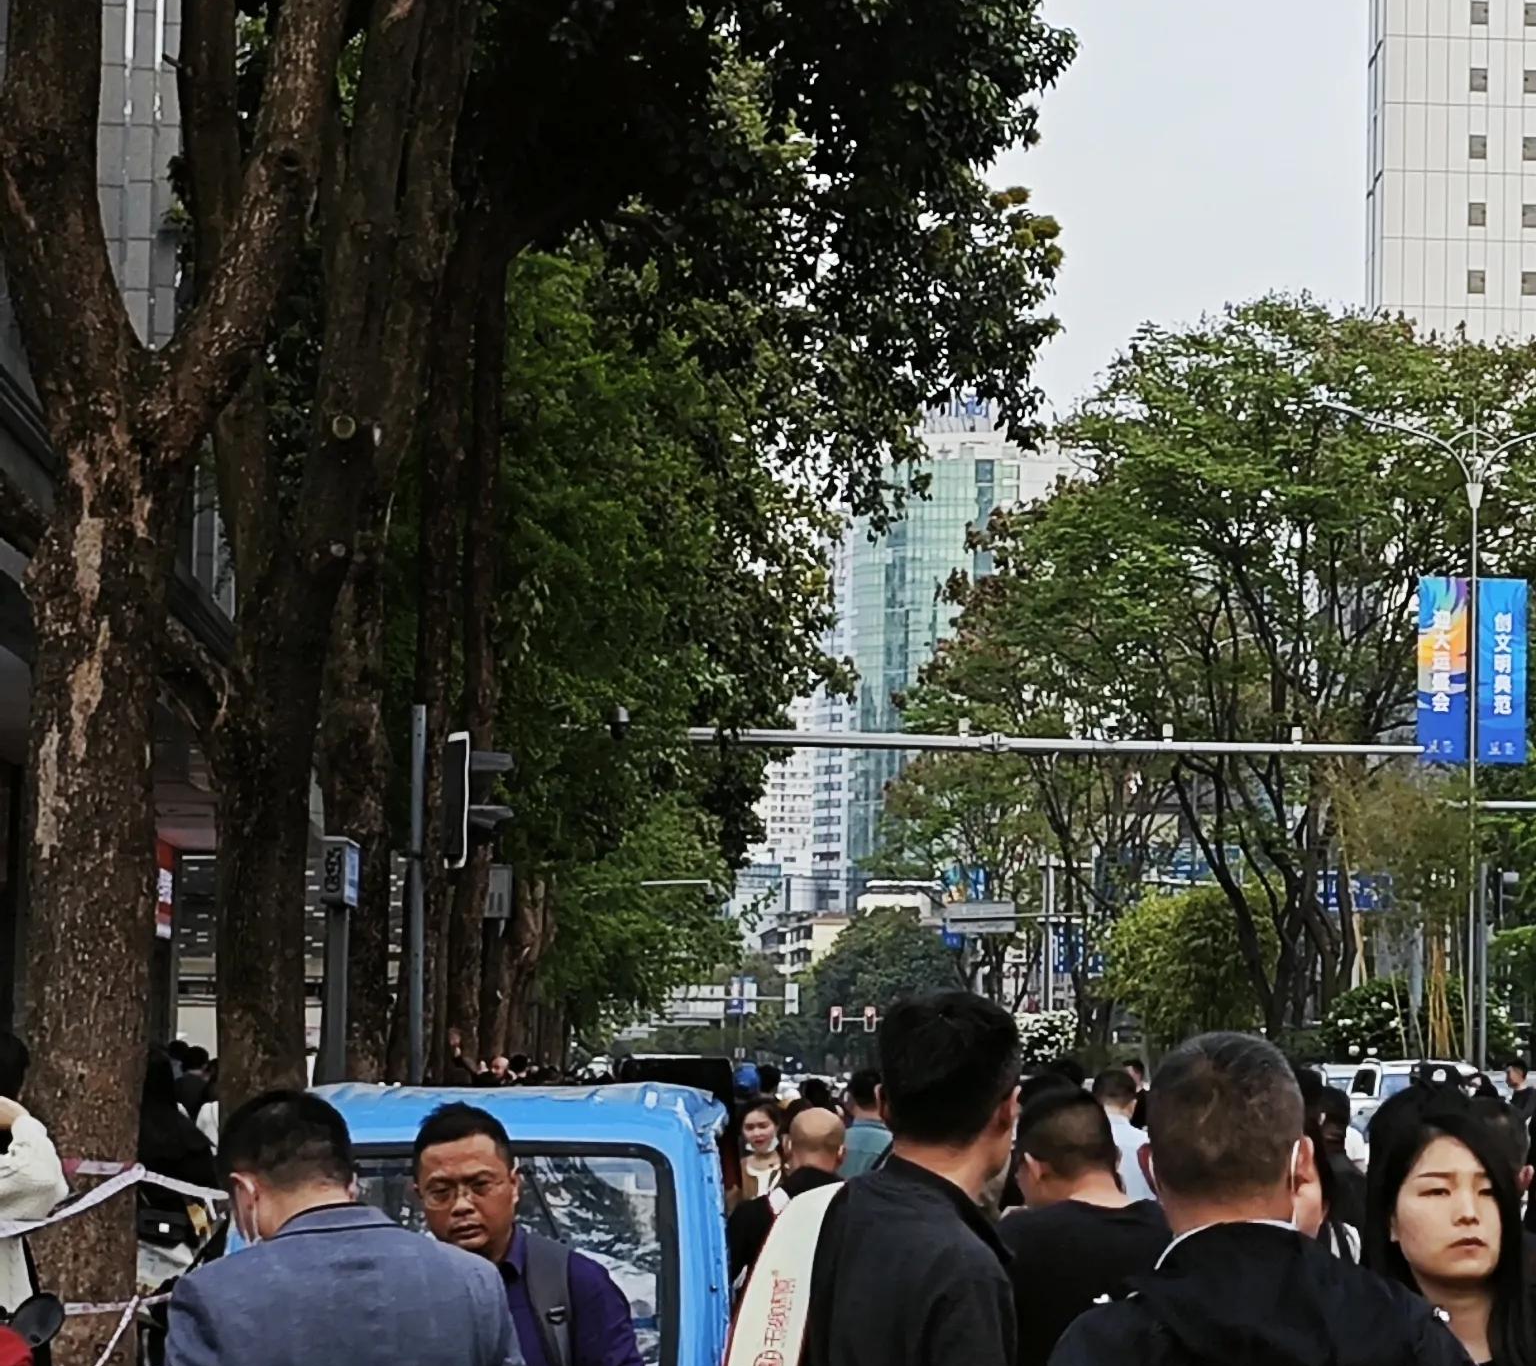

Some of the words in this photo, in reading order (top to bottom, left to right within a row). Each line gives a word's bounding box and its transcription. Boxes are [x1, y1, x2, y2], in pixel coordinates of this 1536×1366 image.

[1493, 612, 1512, 715] 创文明典范
